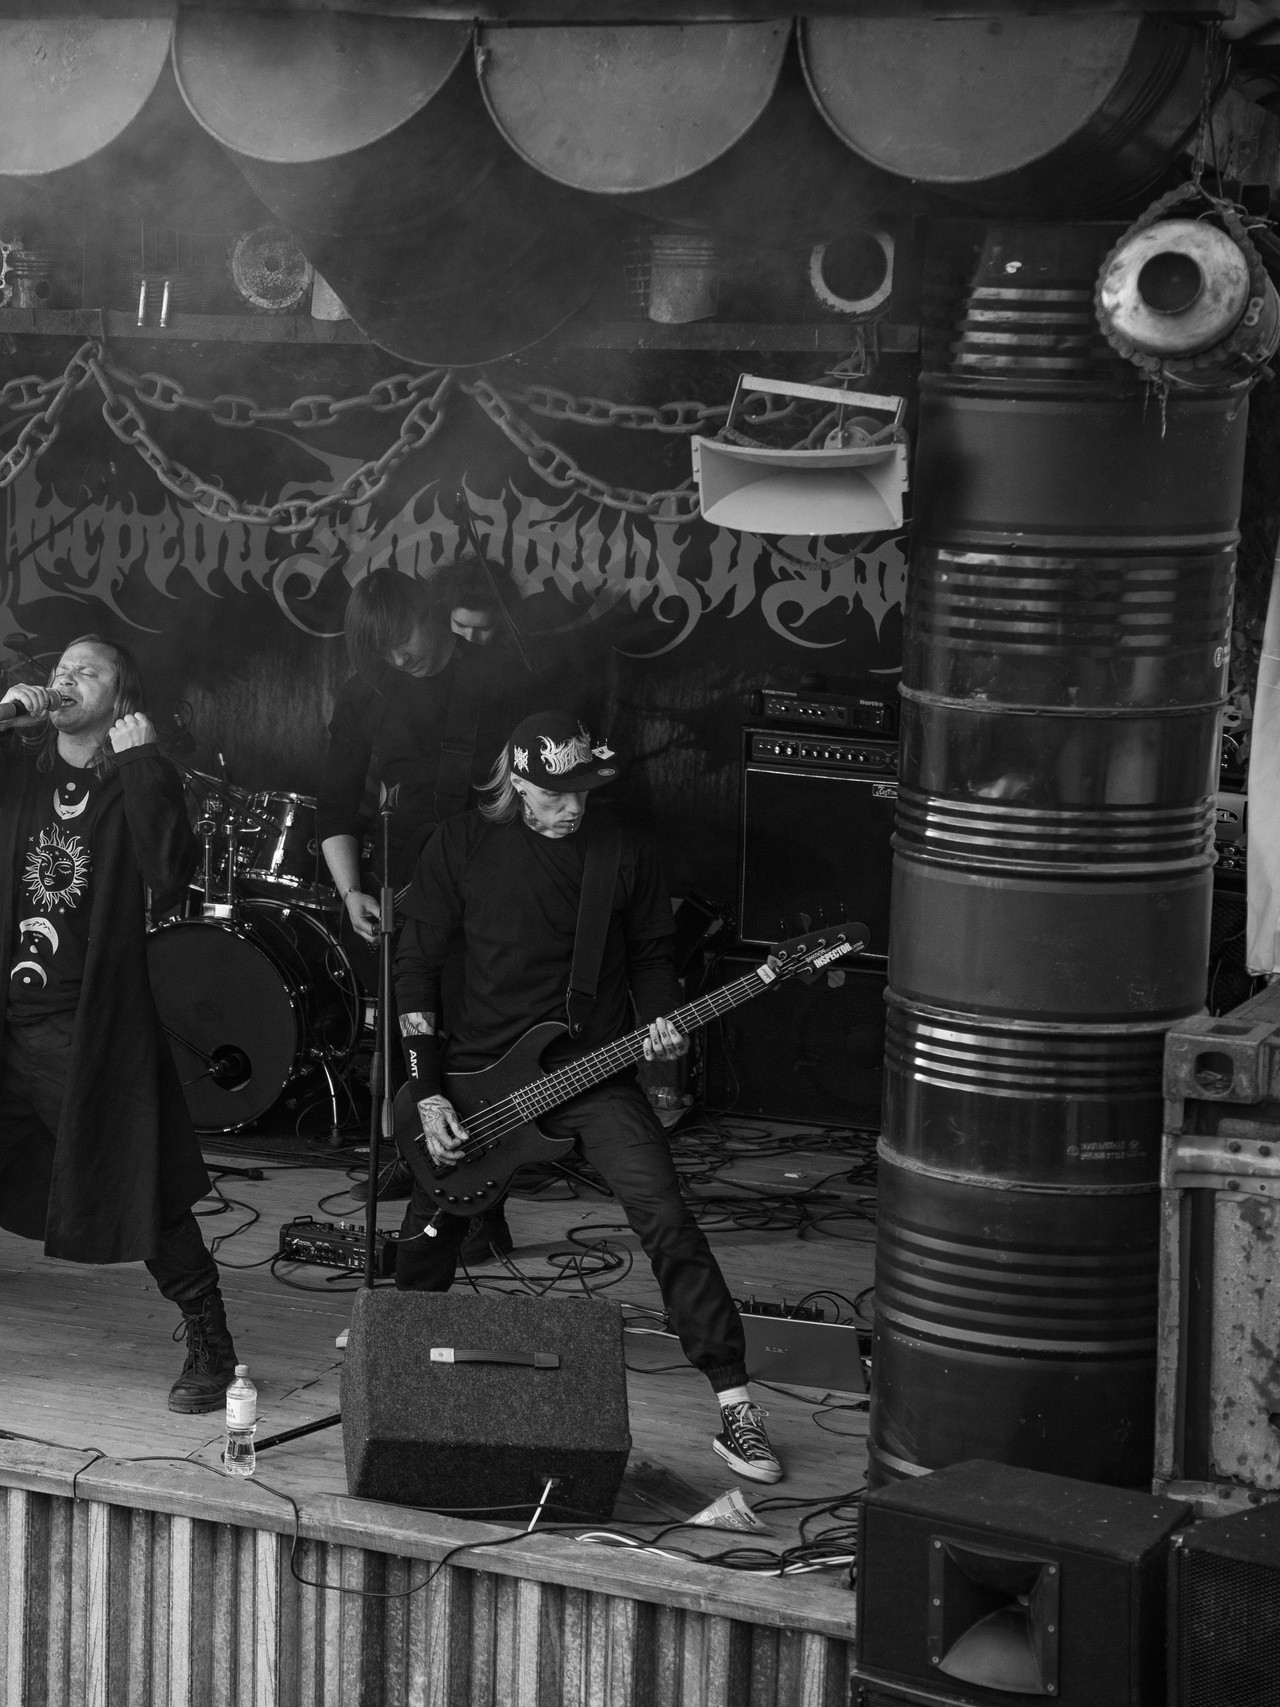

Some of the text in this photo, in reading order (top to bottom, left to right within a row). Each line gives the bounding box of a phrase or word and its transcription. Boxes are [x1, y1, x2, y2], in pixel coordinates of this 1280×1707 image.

[859, 699, 884, 707] Hartke
[813, 942, 853, 969] INSPECTOR
[408, 1049, 419, 1079] AMT
